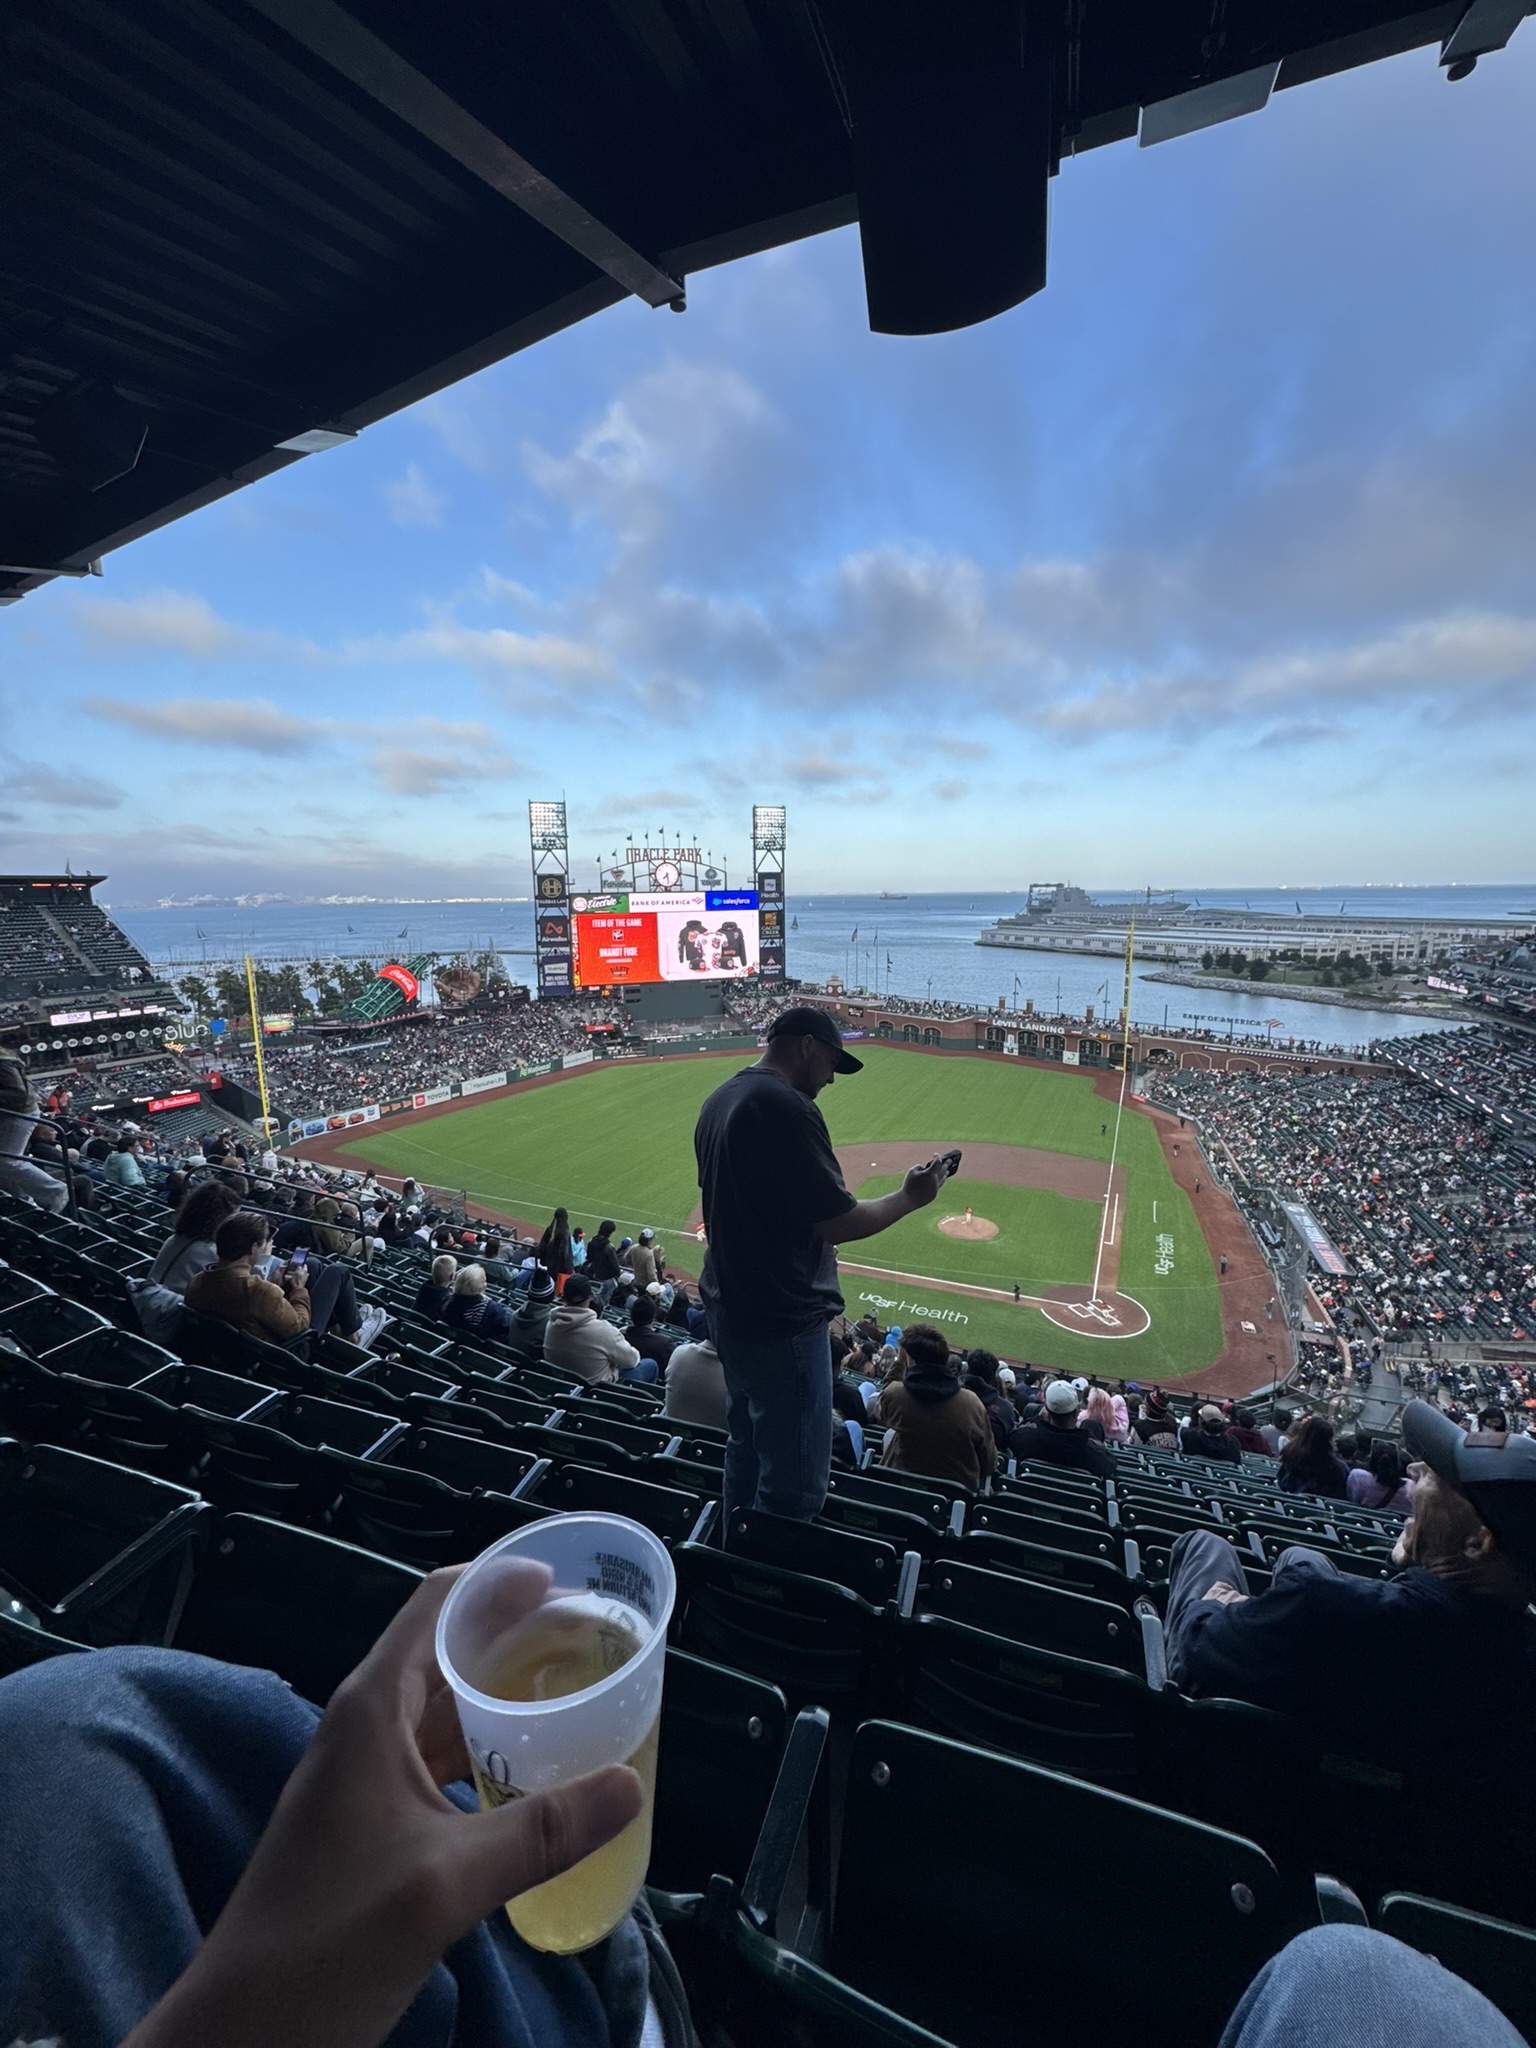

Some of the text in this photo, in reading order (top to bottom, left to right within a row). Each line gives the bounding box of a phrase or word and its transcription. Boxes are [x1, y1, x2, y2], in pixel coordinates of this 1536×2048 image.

[626, 848, 702, 863] ORACLE PARK
[603, 880, 633, 889] Fanatics
[587, 897, 617, 910] Electric
[723, 897, 750, 905] salesforce
[592, 918, 643, 928] ITEM OF THE GAME
[599, 947, 638, 958] BRANDT FUSE
[1182, 1013, 1206, 1021] BANK
[1220, 1017, 1262, 1026] AMERICA
[1020, 1022, 1065, 1034] LANDING
[527, 1062, 551, 1074] National
[494, 1077, 505, 1085] Life
[426, 1091, 449, 1101] TOYOTA
[1154, 1233, 1175, 1260] Health
[858, 1291, 969, 1325] UCSF Health
